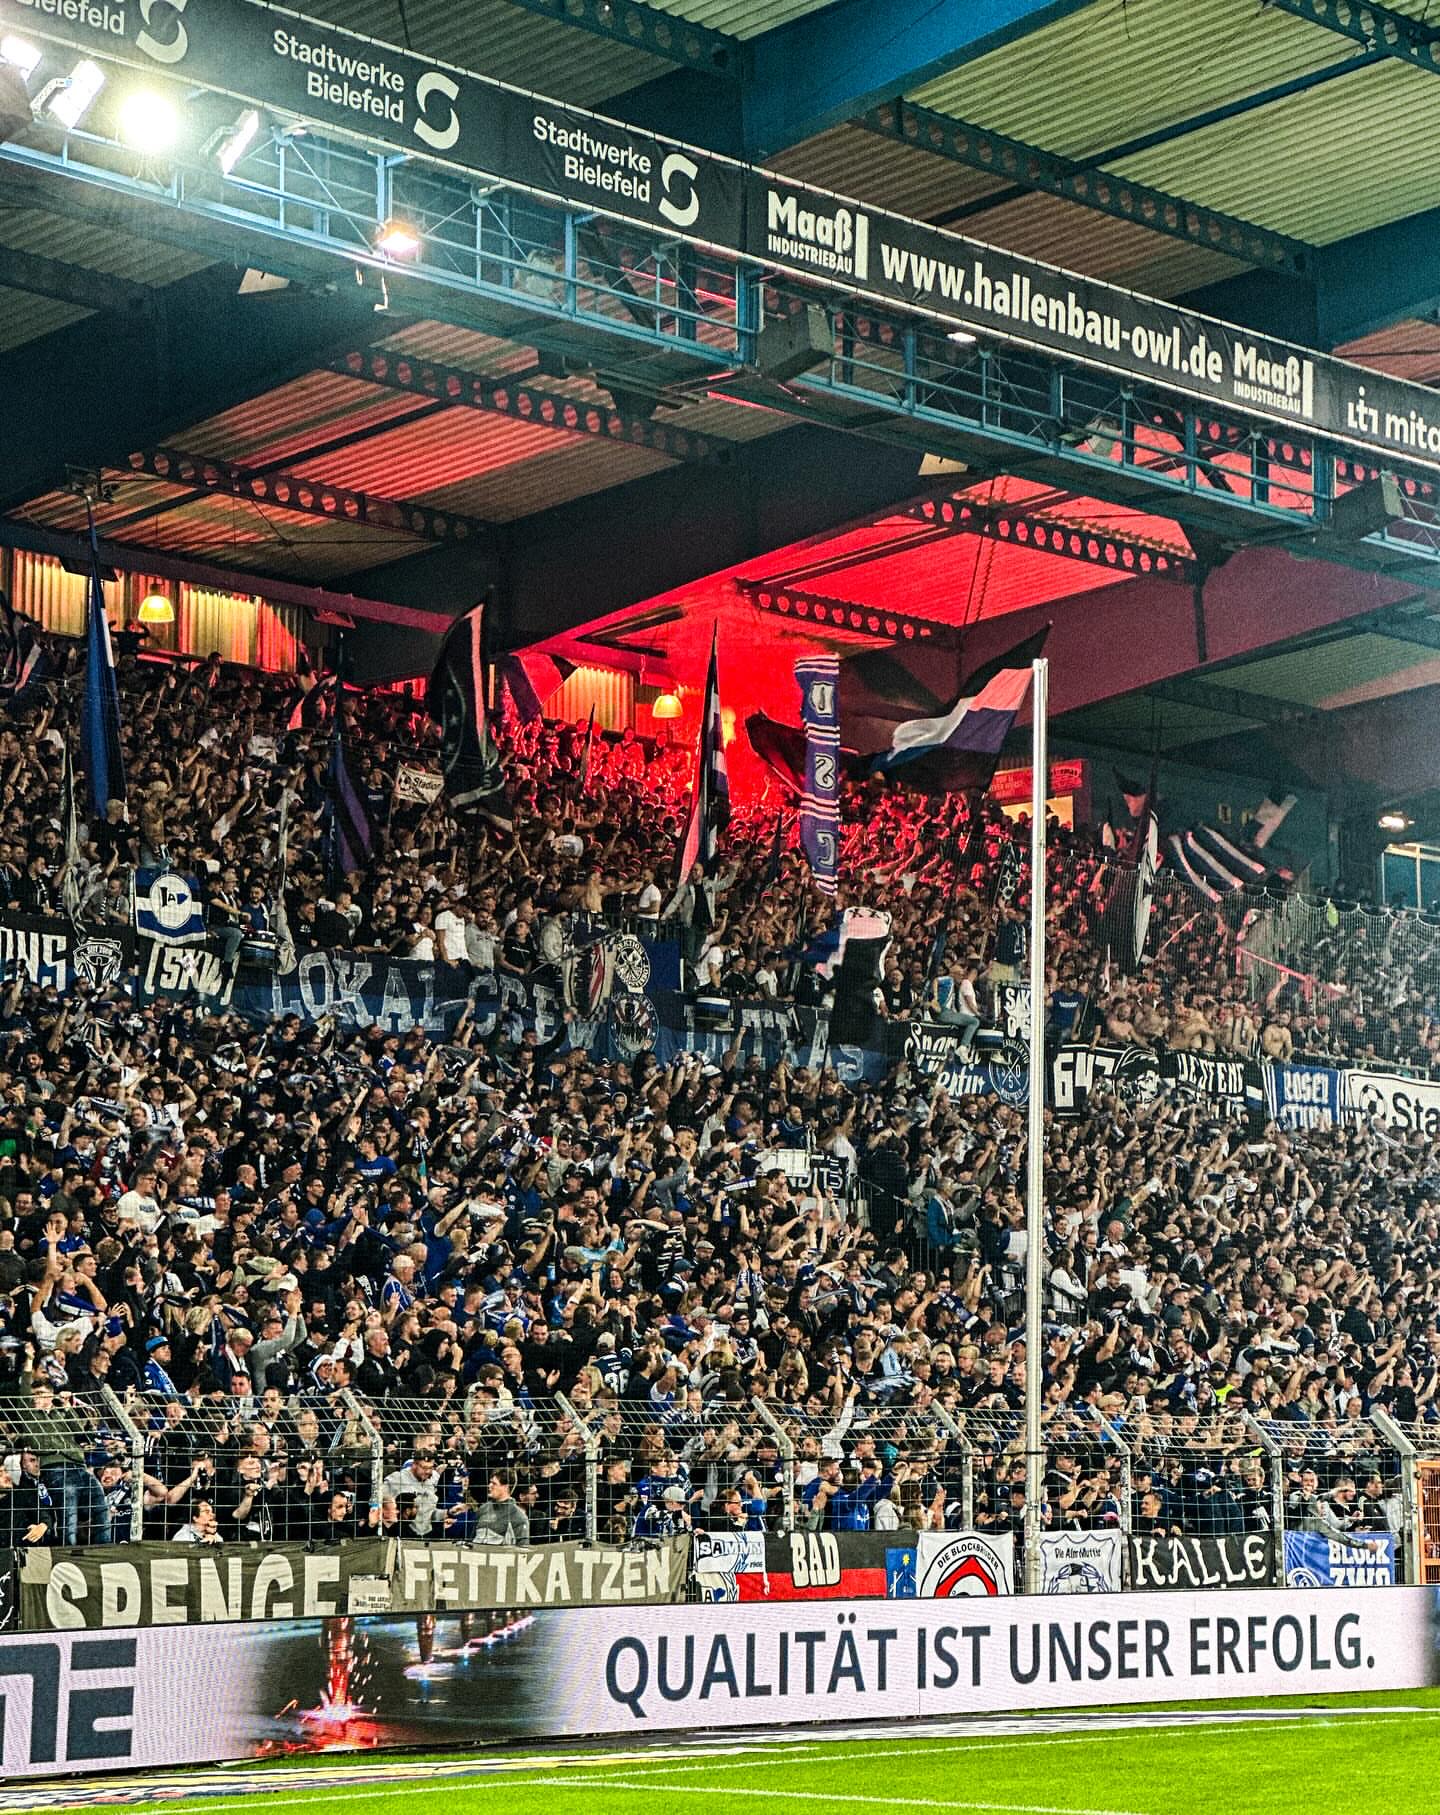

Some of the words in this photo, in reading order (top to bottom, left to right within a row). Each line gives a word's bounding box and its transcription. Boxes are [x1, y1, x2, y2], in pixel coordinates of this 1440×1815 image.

[13, 0, 125, 35] elefeld
[273, 29, 405, 93] Stadtwerke
[306, 71, 404, 123] Bielefeld
[532, 115, 651, 174] Stadtwerke
[564, 154, 651, 203] Bielefeld
[767, 190, 853, 253] Maaß
[767, 233, 853, 274] INDUSTRIEBAU
[880, 243, 1223, 384] www.hallenbau-owl.de
[1233, 341, 1301, 396] Maaß
[1233, 380, 1301, 414] INDUSTRIEBAU
[402, 1547, 671, 1603] FETTKATZEN
[790, 1532, 841, 1588] BAD
[937, 1551, 952, 1569] DIE
[605, 1612, 898, 1719] QUALITÄT
[917, 1625, 991, 1690] IST
[1009, 1619, 1174, 1685] UNSER
[1190, 1612, 1376, 1676] ERFOLG.
